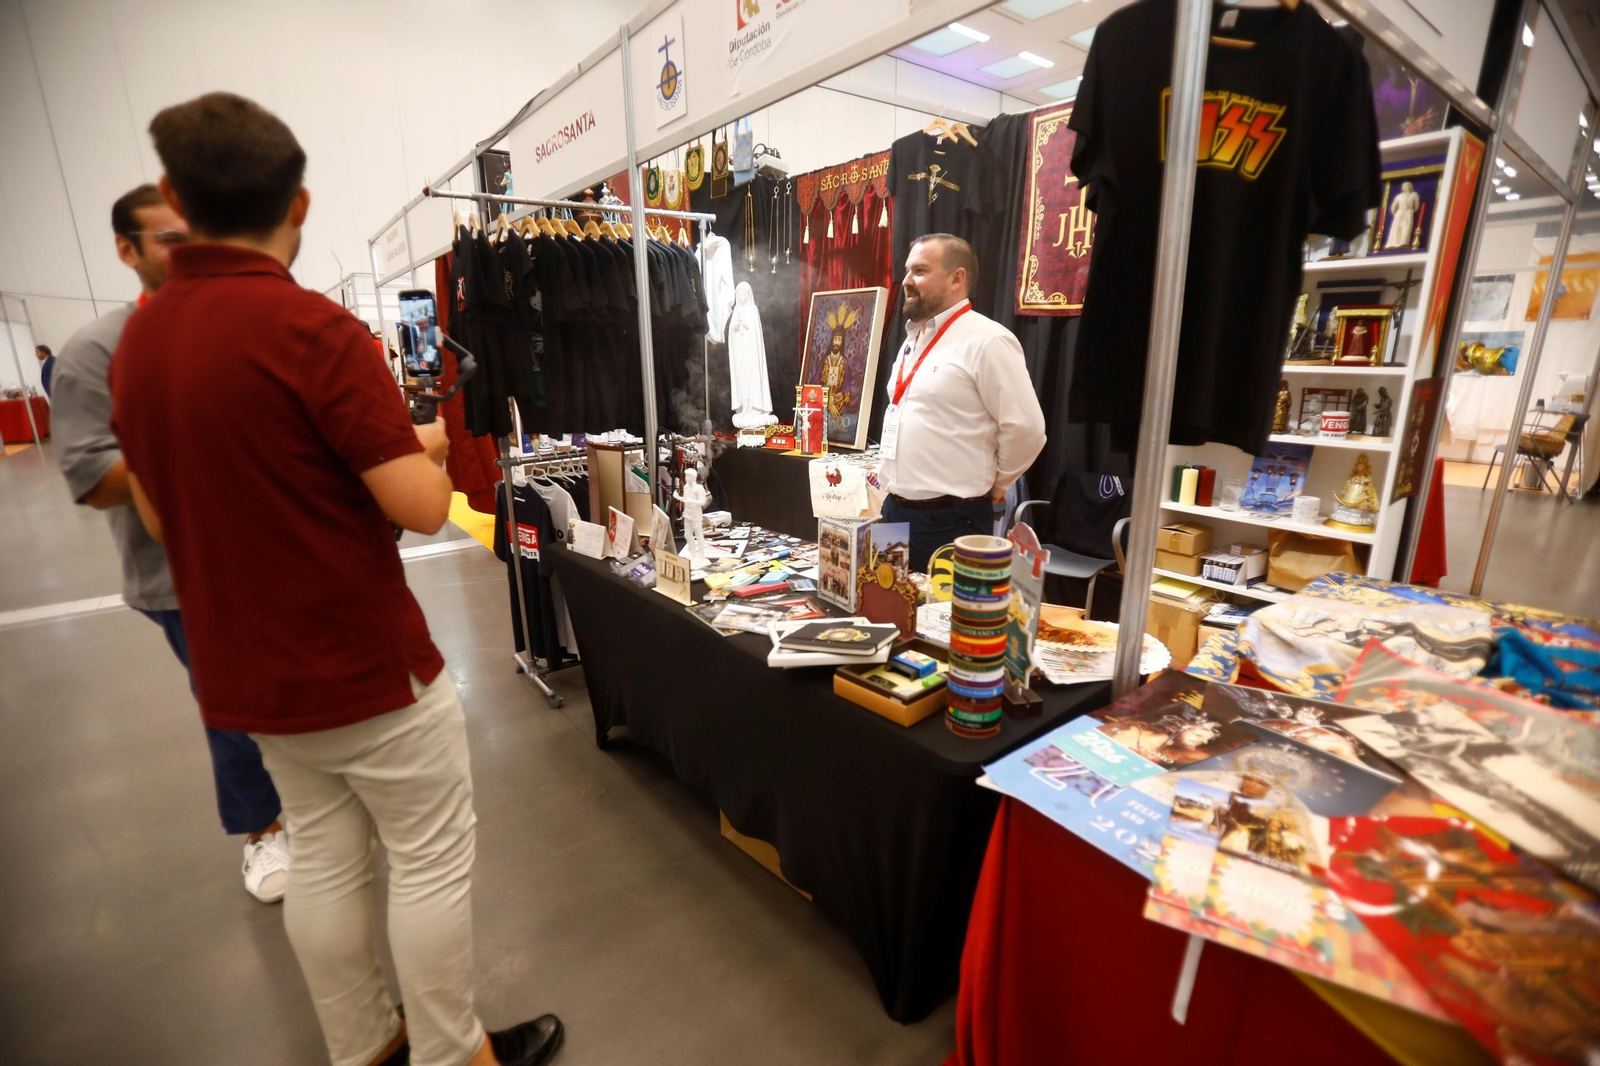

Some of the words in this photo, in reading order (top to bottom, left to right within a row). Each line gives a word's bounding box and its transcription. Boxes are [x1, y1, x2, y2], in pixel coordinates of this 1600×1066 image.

[729, 21, 771, 53] Diputación
[535, 109, 596, 163] SACROSANTA
[1161, 88, 1287, 180] ISS
[1053, 206, 1098, 251] JH
[1127, 799, 1162, 821] FELIZ
